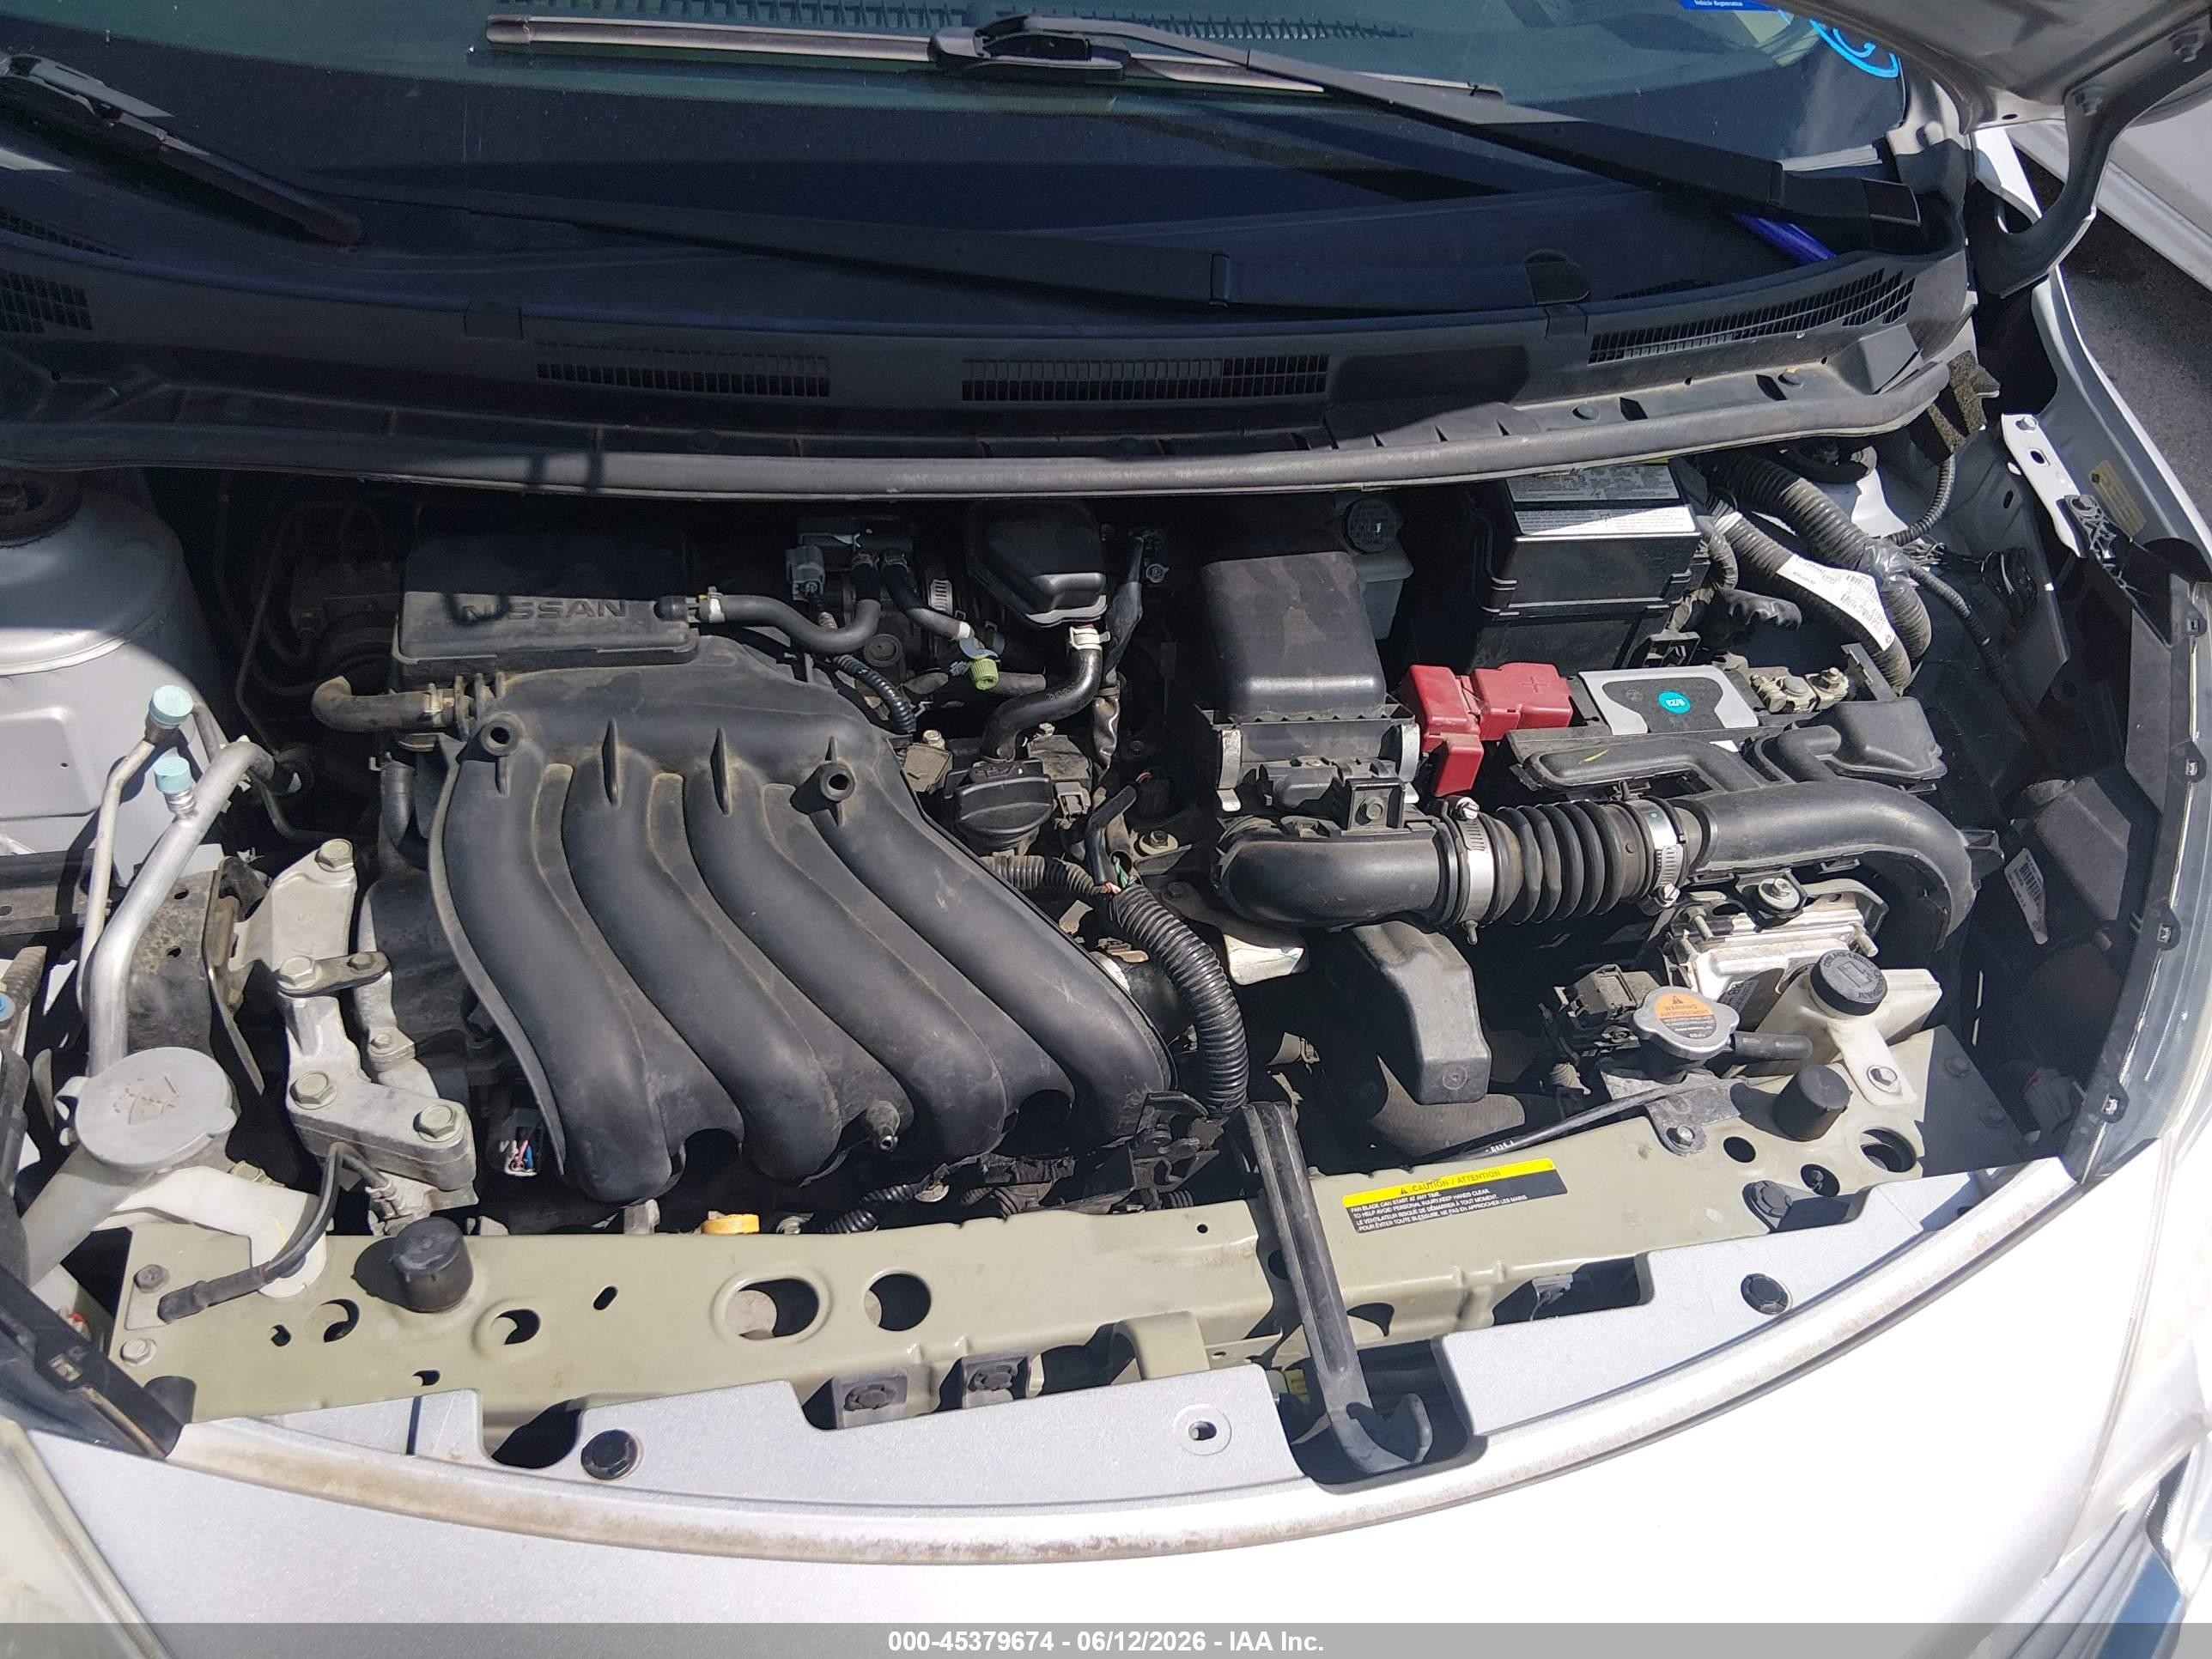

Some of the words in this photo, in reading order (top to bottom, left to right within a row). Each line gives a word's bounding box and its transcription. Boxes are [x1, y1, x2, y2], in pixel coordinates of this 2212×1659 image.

[461, 599, 626, 621] NISSAN
[1412, 1179, 1449, 1193] CAUTION
[1457, 1170, 1501, 1184] ATTENTION
[1358, 1223, 1375, 1232] POUR
[1394, 1217, 1411, 1226] TOUTE
[1468, 1200, 1501, 1212] APPROCHER
[1362, 1209, 1376, 1218] HELP
[1393, 1201, 1422, 1213] PERSONAL
[1453, 1190, 1472, 1199] HANDS
[1362, 1203, 1380, 1212] BLADE
[1392, 1197, 1408, 1206] START
[1364, 1212, 1398, 1224] VENTILATEUR
[1398, 1209, 1419, 1219] RISQUE
[1462, 1197, 1474, 1206] TOUT
